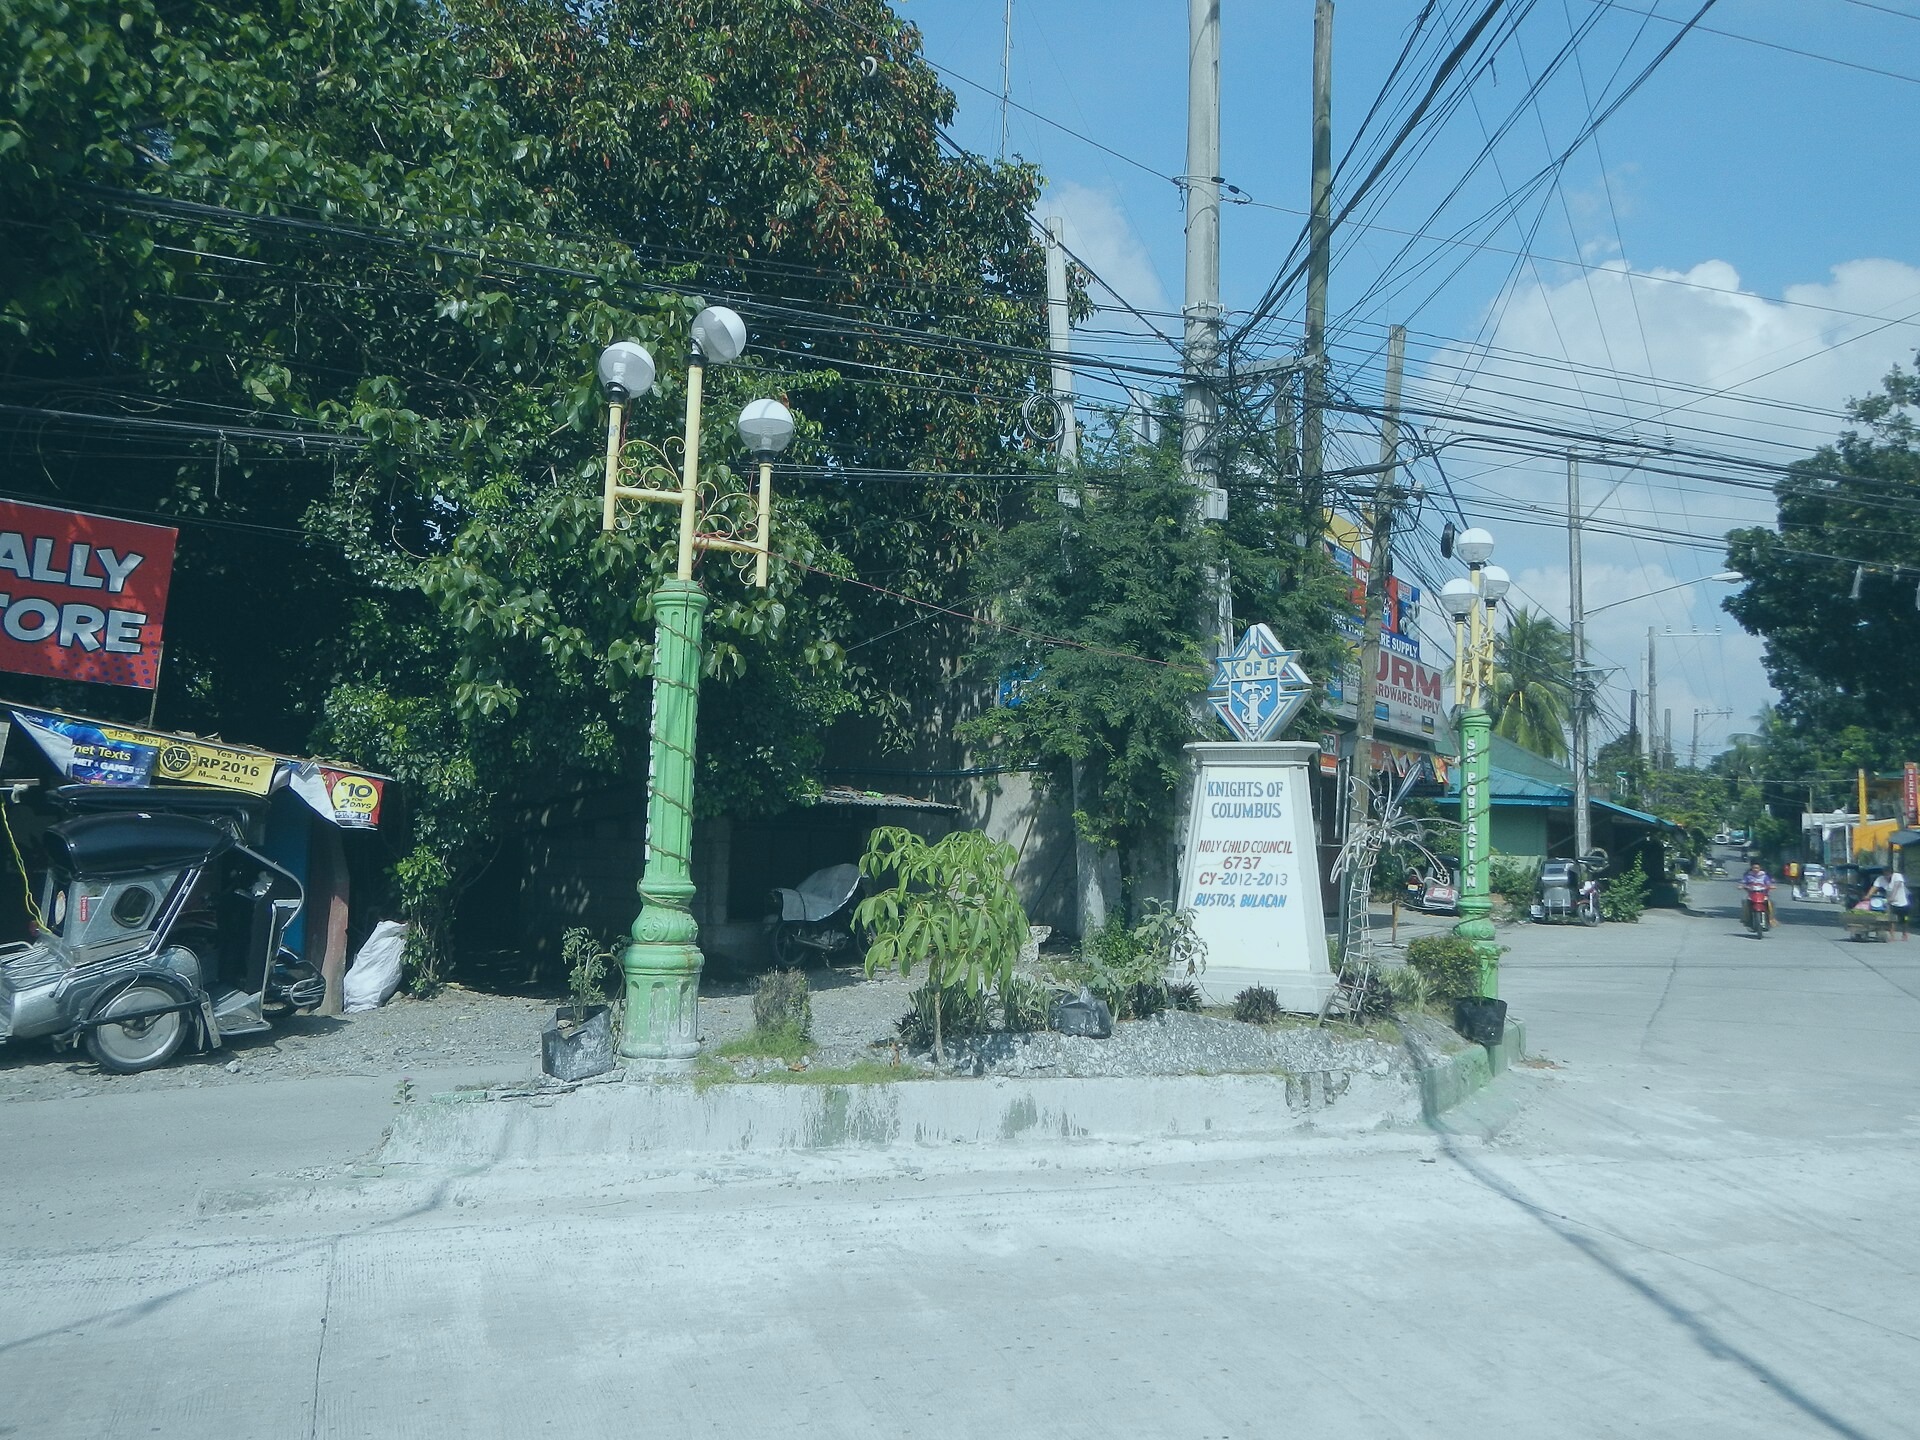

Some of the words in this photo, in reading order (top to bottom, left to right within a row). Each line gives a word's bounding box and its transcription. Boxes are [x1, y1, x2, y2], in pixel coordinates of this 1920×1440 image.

[1391, 638, 1418, 659] SUPPLY
[1231, 661, 1240, 678] K
[1244, 661, 1262, 676] OF
[1267, 658, 1277, 675] C
[1413, 695, 1440, 716] SUPPLY
[99, 744, 131, 761] Texts
[216, 749, 232, 759] Yes
[235, 753, 246, 761] To
[100, 761, 135, 774] GAMES
[1207, 781, 1264, 798] KNIGHTS
[1266, 781, 1284, 798] OF
[340, 798, 350, 808] 2
[349, 801, 372, 809] DAYS
[1211, 802, 1282, 819] COLUMBUS
[1466, 771, 1477, 888] POBLACION
[1198, 840, 1222, 853] HOLY
[1222, 840, 1250, 854] CHILD
[1251, 840, 1293, 855] COUNCIL
[1223, 856, 1262, 870] 6737
[1199, 871, 1288, 886] CY-2012-2013
[1240, 893, 1287, 908] BULACAN
